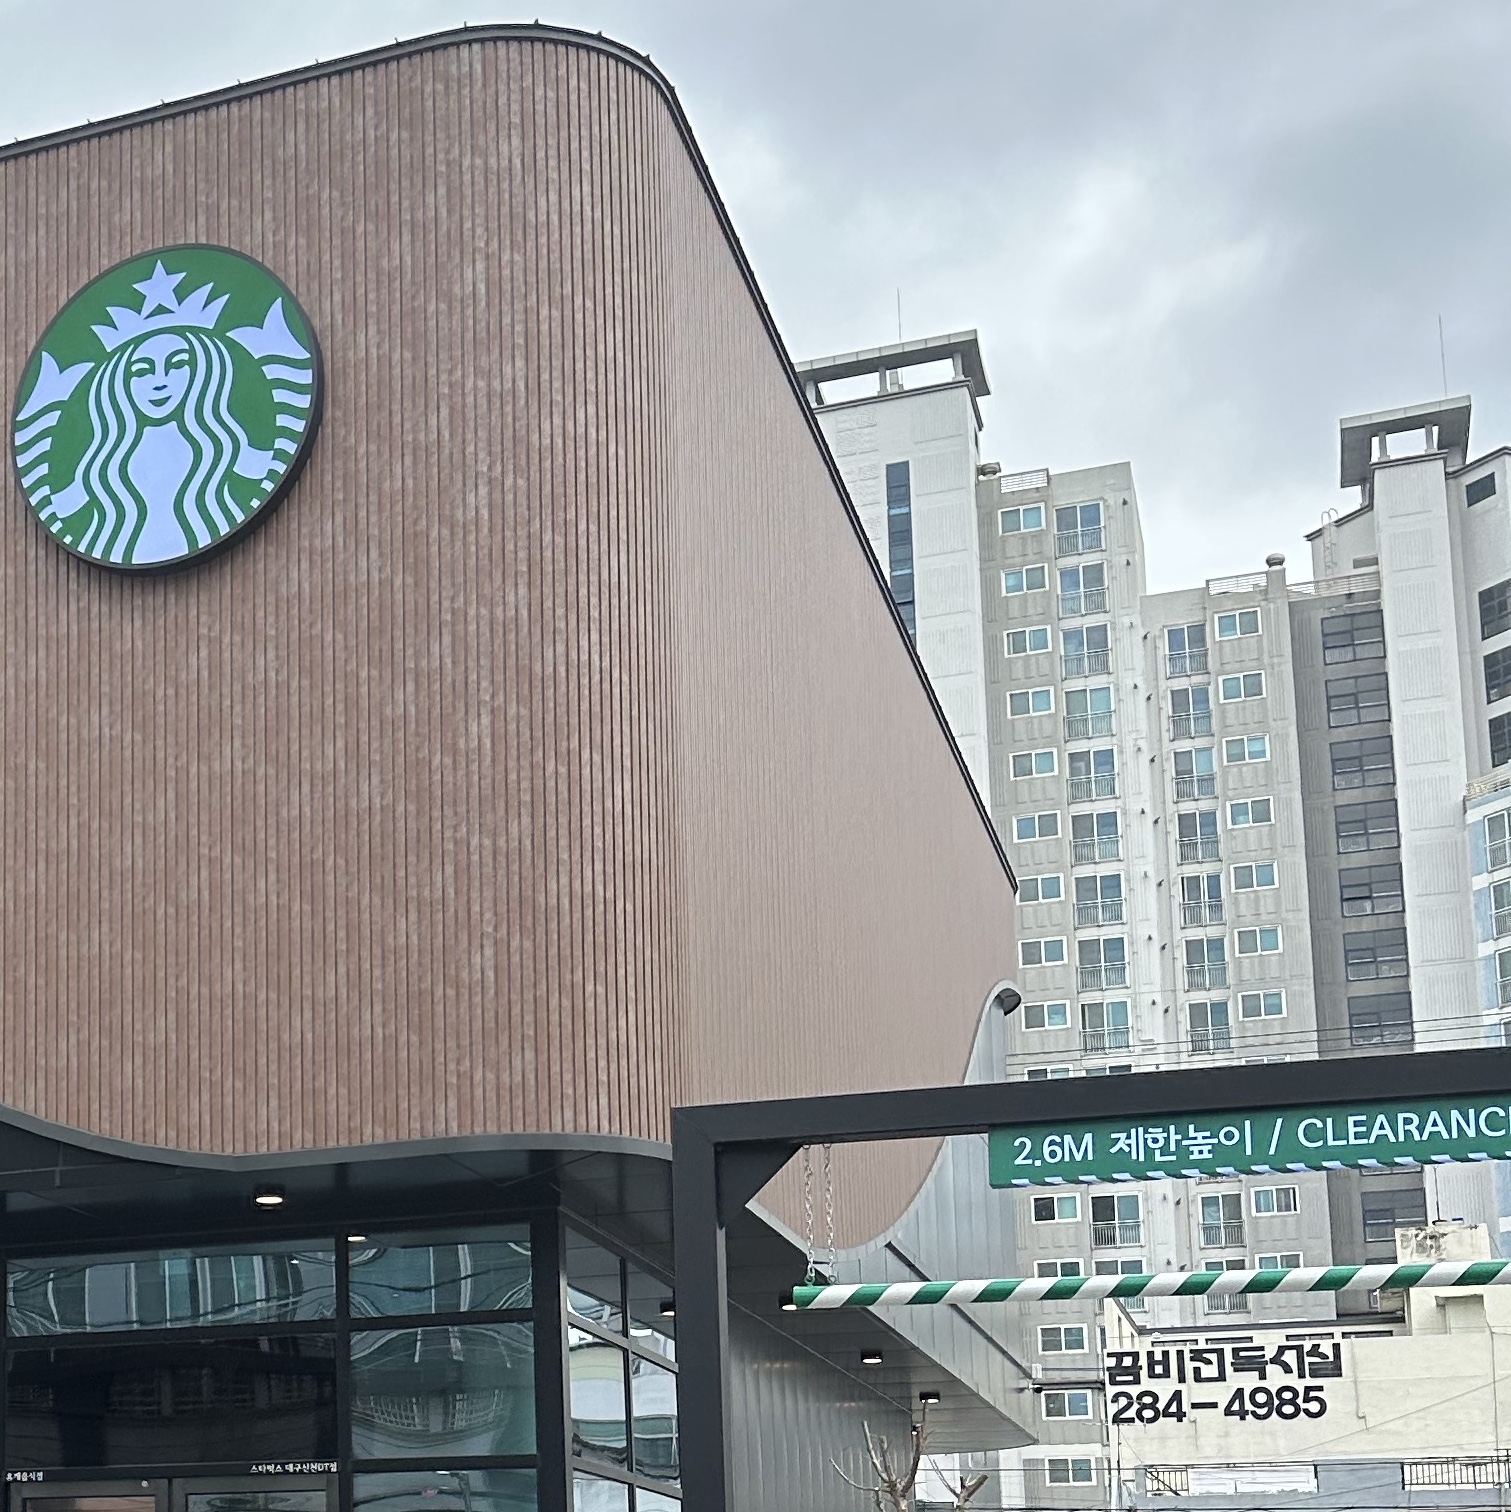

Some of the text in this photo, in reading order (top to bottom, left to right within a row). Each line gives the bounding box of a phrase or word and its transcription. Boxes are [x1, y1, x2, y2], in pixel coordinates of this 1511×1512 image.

[1013, 1133, 1093, 1168] 2.6M
[1109, 1118, 1252, 1162] 제한높이
[1297, 1105, 1511, 1149] CLEARANC
[1111, 1385, 1327, 1424] 284-4985
[250, 1464, 283, 1475] 스타벅스
